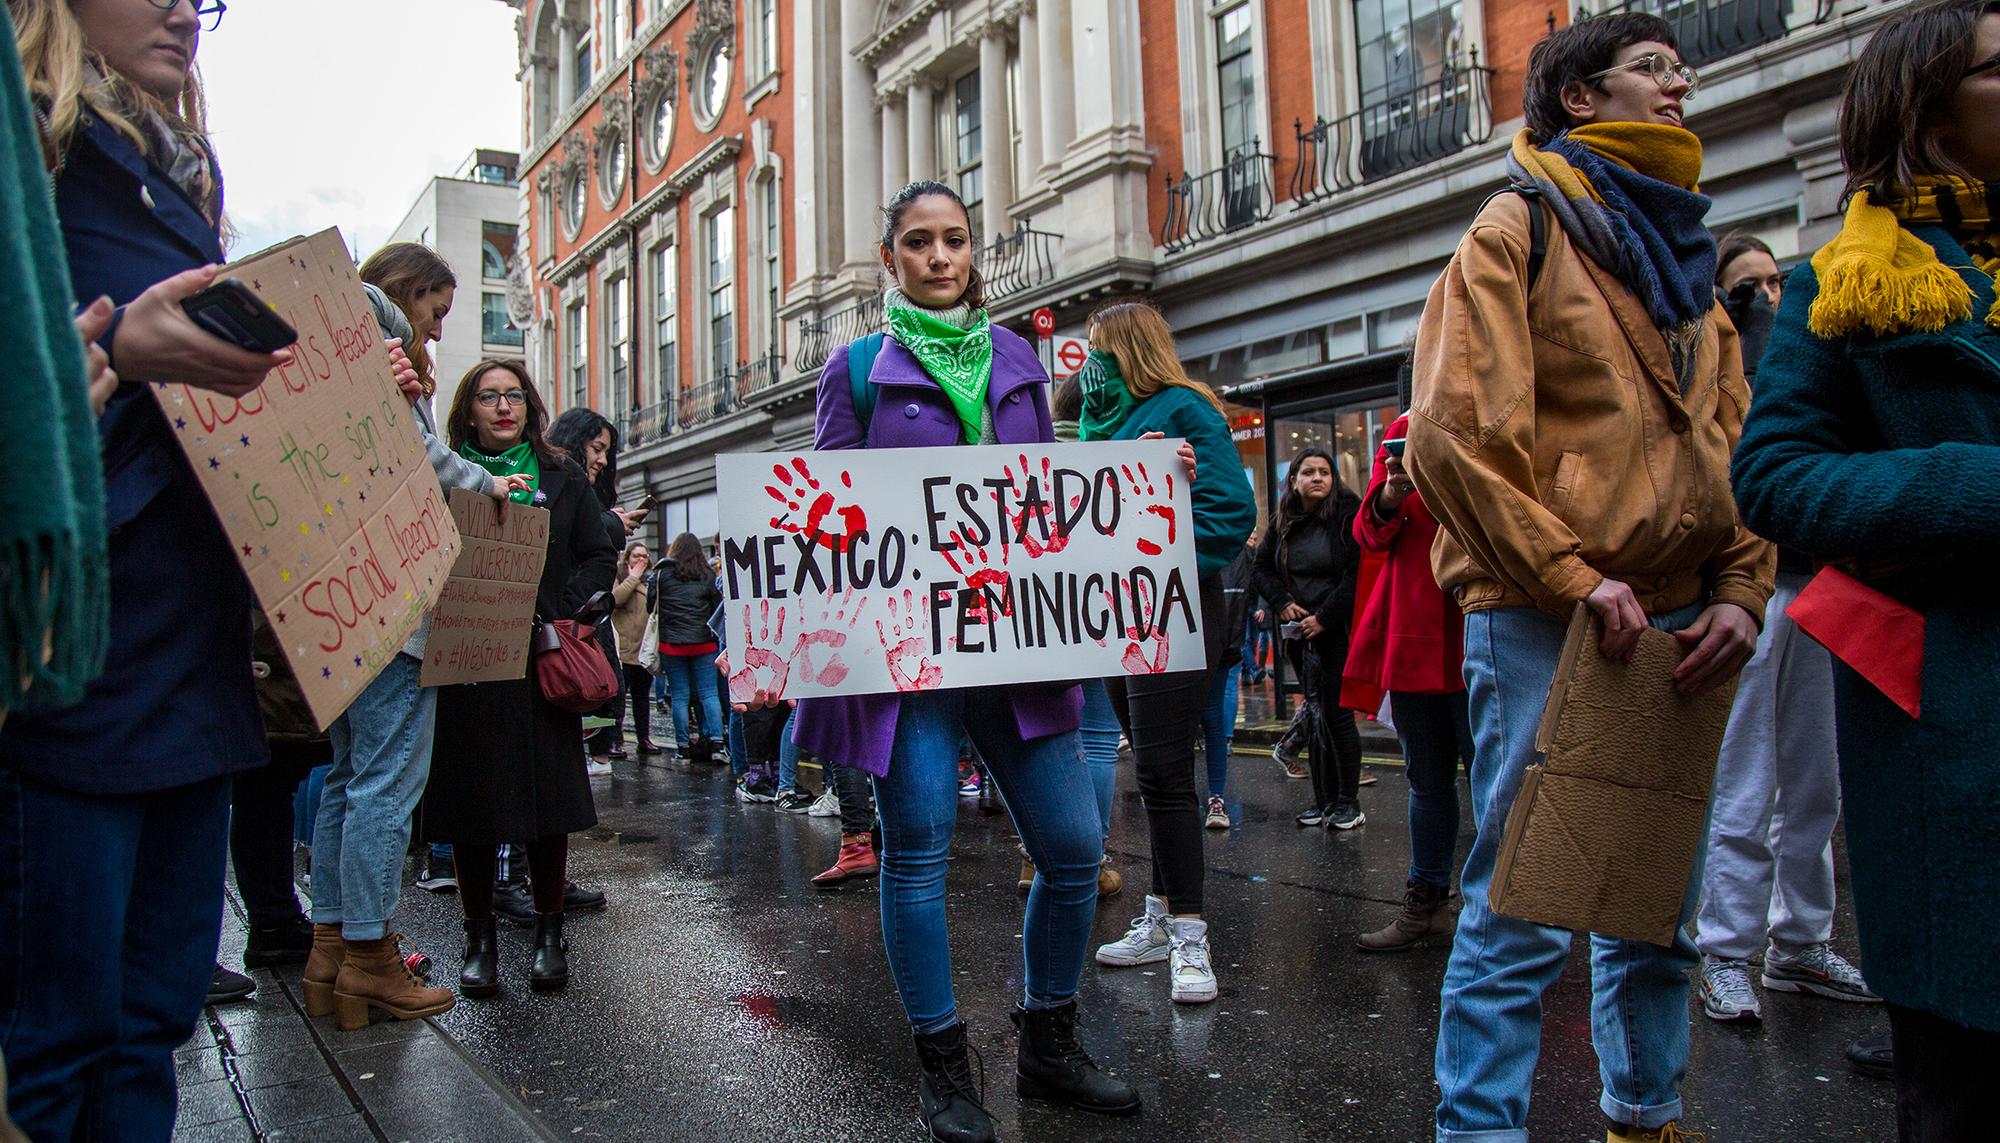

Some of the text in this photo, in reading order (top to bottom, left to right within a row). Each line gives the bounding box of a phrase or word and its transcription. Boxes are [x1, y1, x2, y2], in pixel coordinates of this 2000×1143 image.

[314, 292, 382, 386] freedom
[233, 371, 407, 531] is the sign of
[384, 483, 450, 597] freedom
[511, 512, 536, 546] NOS
[923, 466, 1121, 553] ESTADO
[471, 544, 541, 584] QUEREMOS!
[448, 637, 508, 672] #WeStrike
[929, 565, 1198, 656] FEMINICIDA
